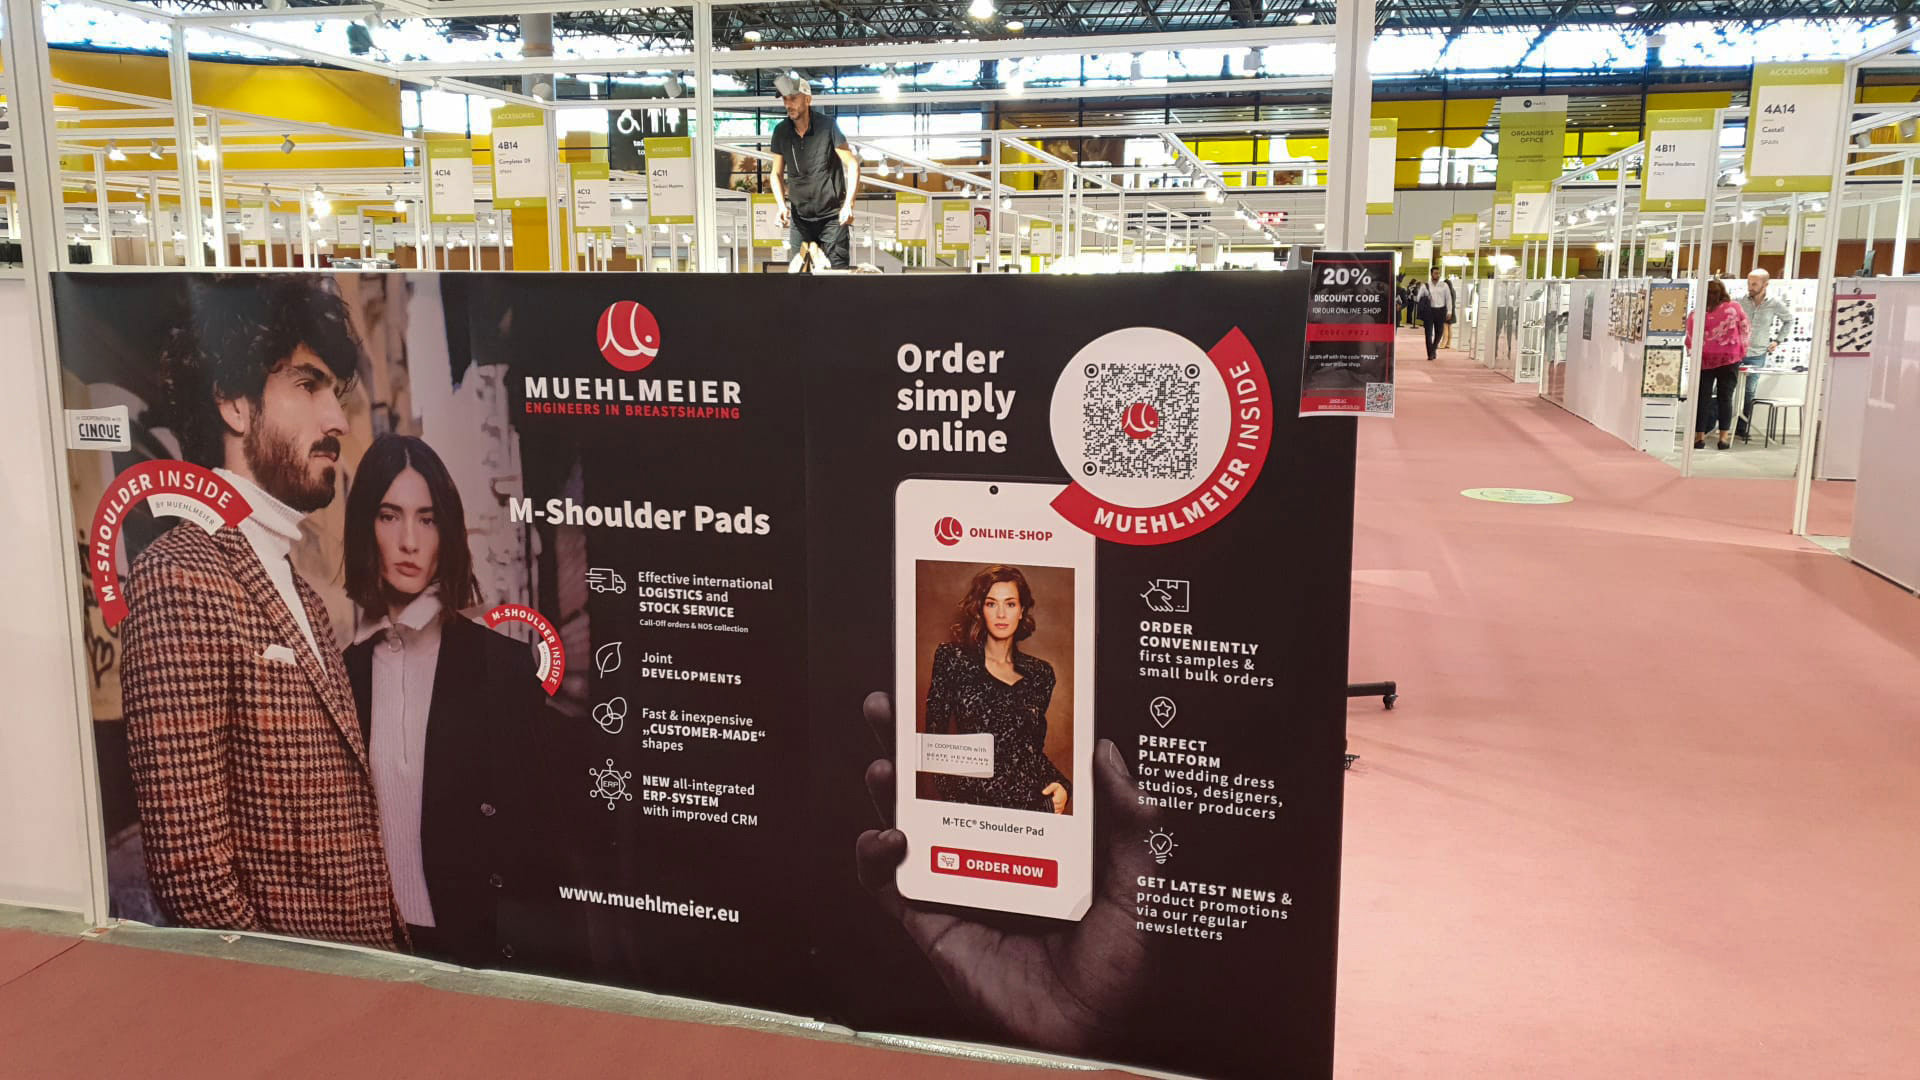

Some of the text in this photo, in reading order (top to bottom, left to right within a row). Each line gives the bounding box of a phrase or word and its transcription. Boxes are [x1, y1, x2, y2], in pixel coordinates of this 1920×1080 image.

[1769, 67, 1829, 76] ACCESSORIES
[1764, 104, 1796, 114] 4A14
[498, 142, 518, 150] 4B14
[1323, 268, 1372, 285] 20%
[1314, 294, 1380, 302] DISCOUNT CODE
[897, 342, 1005, 374] Order
[524, 376, 742, 404] MUEHLMEIER
[896, 379, 1016, 420] simply
[525, 402, 741, 419] ENGINEERS IN BREASTSHAPING
[78, 423, 121, 438] CINQUE
[897, 420, 1008, 453] online
[1093, 360, 1261, 534] MUEHLMEIER INSIDE
[166, 500, 216, 526] MUEHLMEIER
[508, 497, 771, 536] M-Shoulder Pads
[97, 470, 233, 603] M-SHOULDER INSIDE
[969, 527, 1053, 542] ONLINE-SHOP
[638, 571, 774, 591] Effective international
[638, 586, 729, 603] LOGISTICS and
[639, 602, 735, 618] STOCK SERVICE
[639, 618, 666, 628] Call-Off
[667, 620, 690, 629] orders
[690, 622, 697, 630] &
[714, 623, 749, 633] collection
[1140, 620, 1193, 635] ORDER
[491, 608, 561, 685] M-SHOULDER INSIDE
[1140, 636, 1259, 656] CONVENIENTLY
[641, 652, 673, 665] Joint
[1139, 650, 1255, 671] first samples &
[642, 667, 742, 685] DEVELOPMENTS
[1139, 666, 1274, 687] small bulk orders
[642, 708, 753, 727] Fast & inexpensive
[641, 738, 684, 752] shapes
[934, 742, 972, 752] COOPERATION
[1138, 734, 1207, 752] PERFECT
[1138, 750, 1221, 768] PLATFORM
[602, 780, 619, 788] ERP
[642, 775, 756, 796] NEW all-integrated
[1138, 763, 1275, 790] for wedding dress
[642, 789, 719, 808] ERP-SYSTEM
[1138, 780, 1283, 808] studios, designers,
[642, 805, 758, 826] with improved CRM
[1138, 794, 1276, 820] smaller producers
[979, 820, 1024, 834] Shoulder
[1026, 826, 1045, 836] Pad
[966, 858, 1044, 878] ORDER NOW
[1136, 876, 1293, 906] GET LATEST NEWS &
[558, 886, 740, 923] www.muehlmeier.eu
[1136, 892, 1288, 920] product promotions
[1136, 905, 1248, 929] via our regular
[1136, 920, 1223, 941] newsletters
